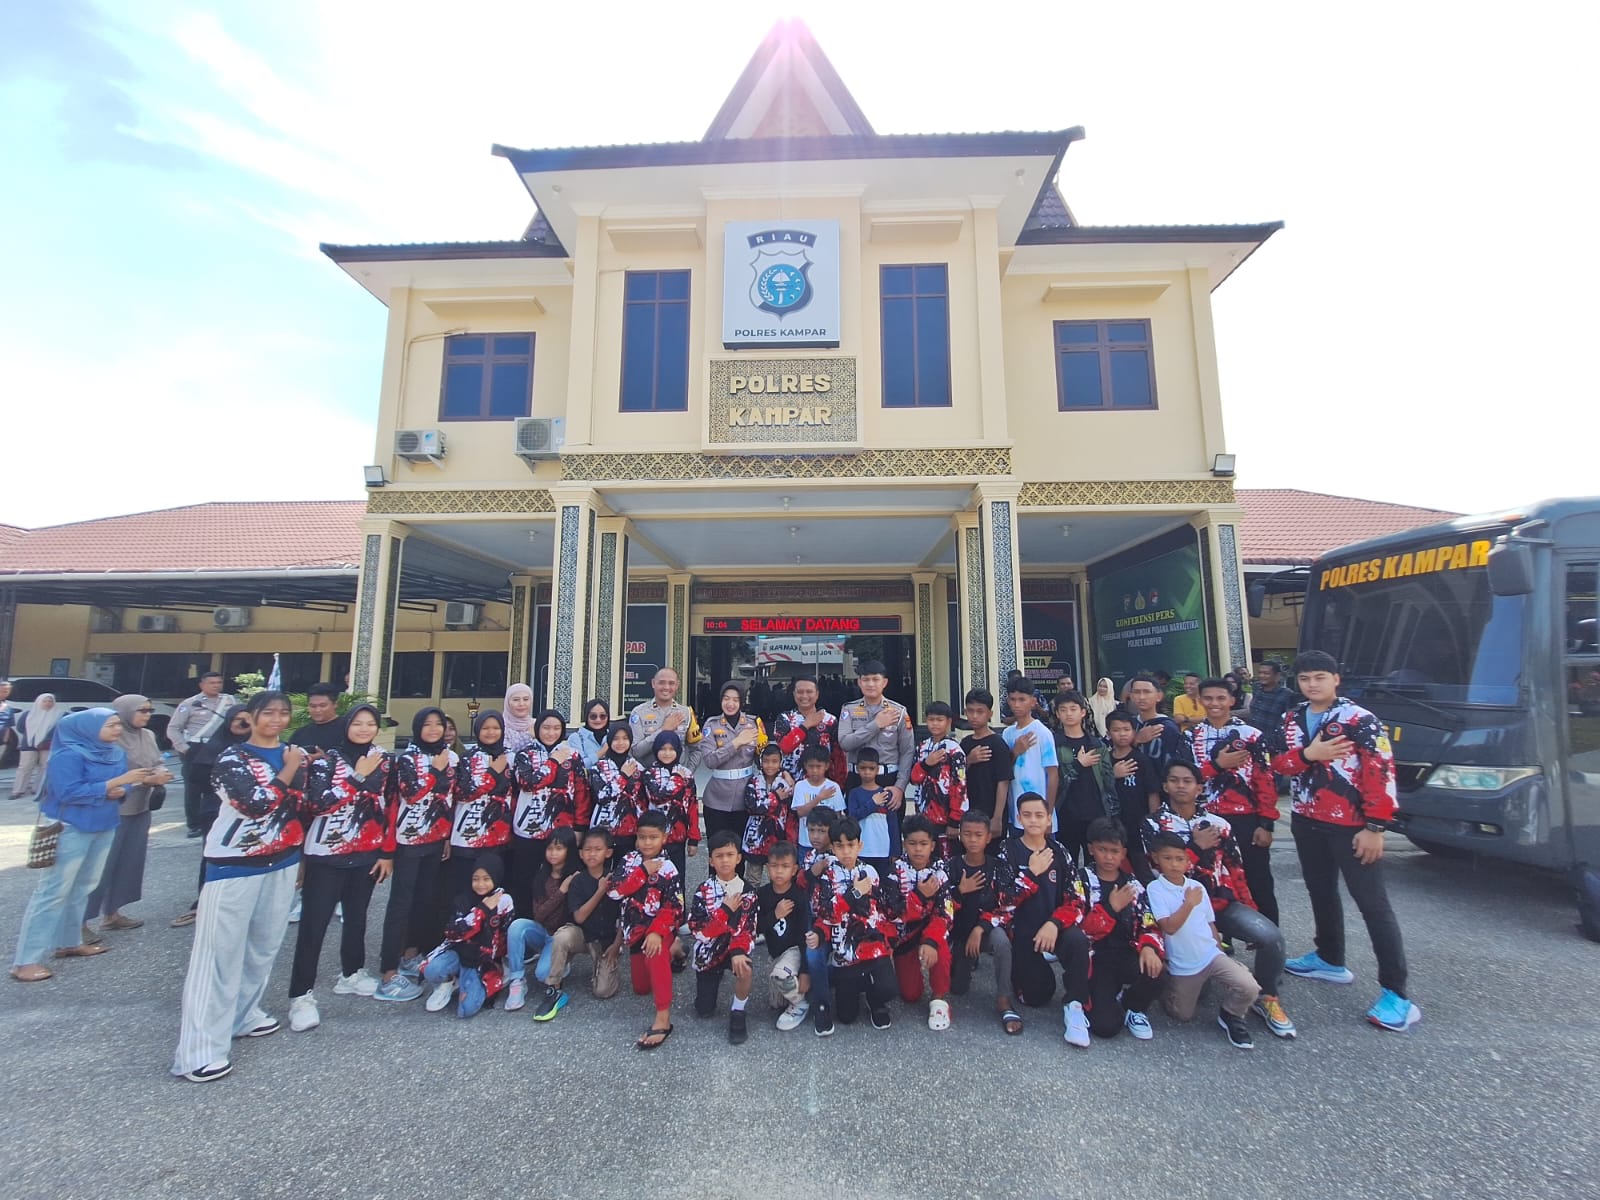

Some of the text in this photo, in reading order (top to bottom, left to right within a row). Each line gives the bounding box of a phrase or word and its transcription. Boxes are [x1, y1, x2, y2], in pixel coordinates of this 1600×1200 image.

[756, 233, 808, 244] RIAU
[734, 328, 827, 337] POLRES KAMPAR
[730, 374, 831, 394] POLRES
[729, 407, 832, 426] KAMPAR
[1320, 540, 1491, 590] POLRES KAMPAR
[741, 618, 802, 632] SELAMAT
[806, 617, 860, 631] DATANG
[1115, 608, 1176, 628] KONFERENSI PERS
[625, 641, 646, 654] PAR
[1023, 638, 1057, 652] AMPAR
